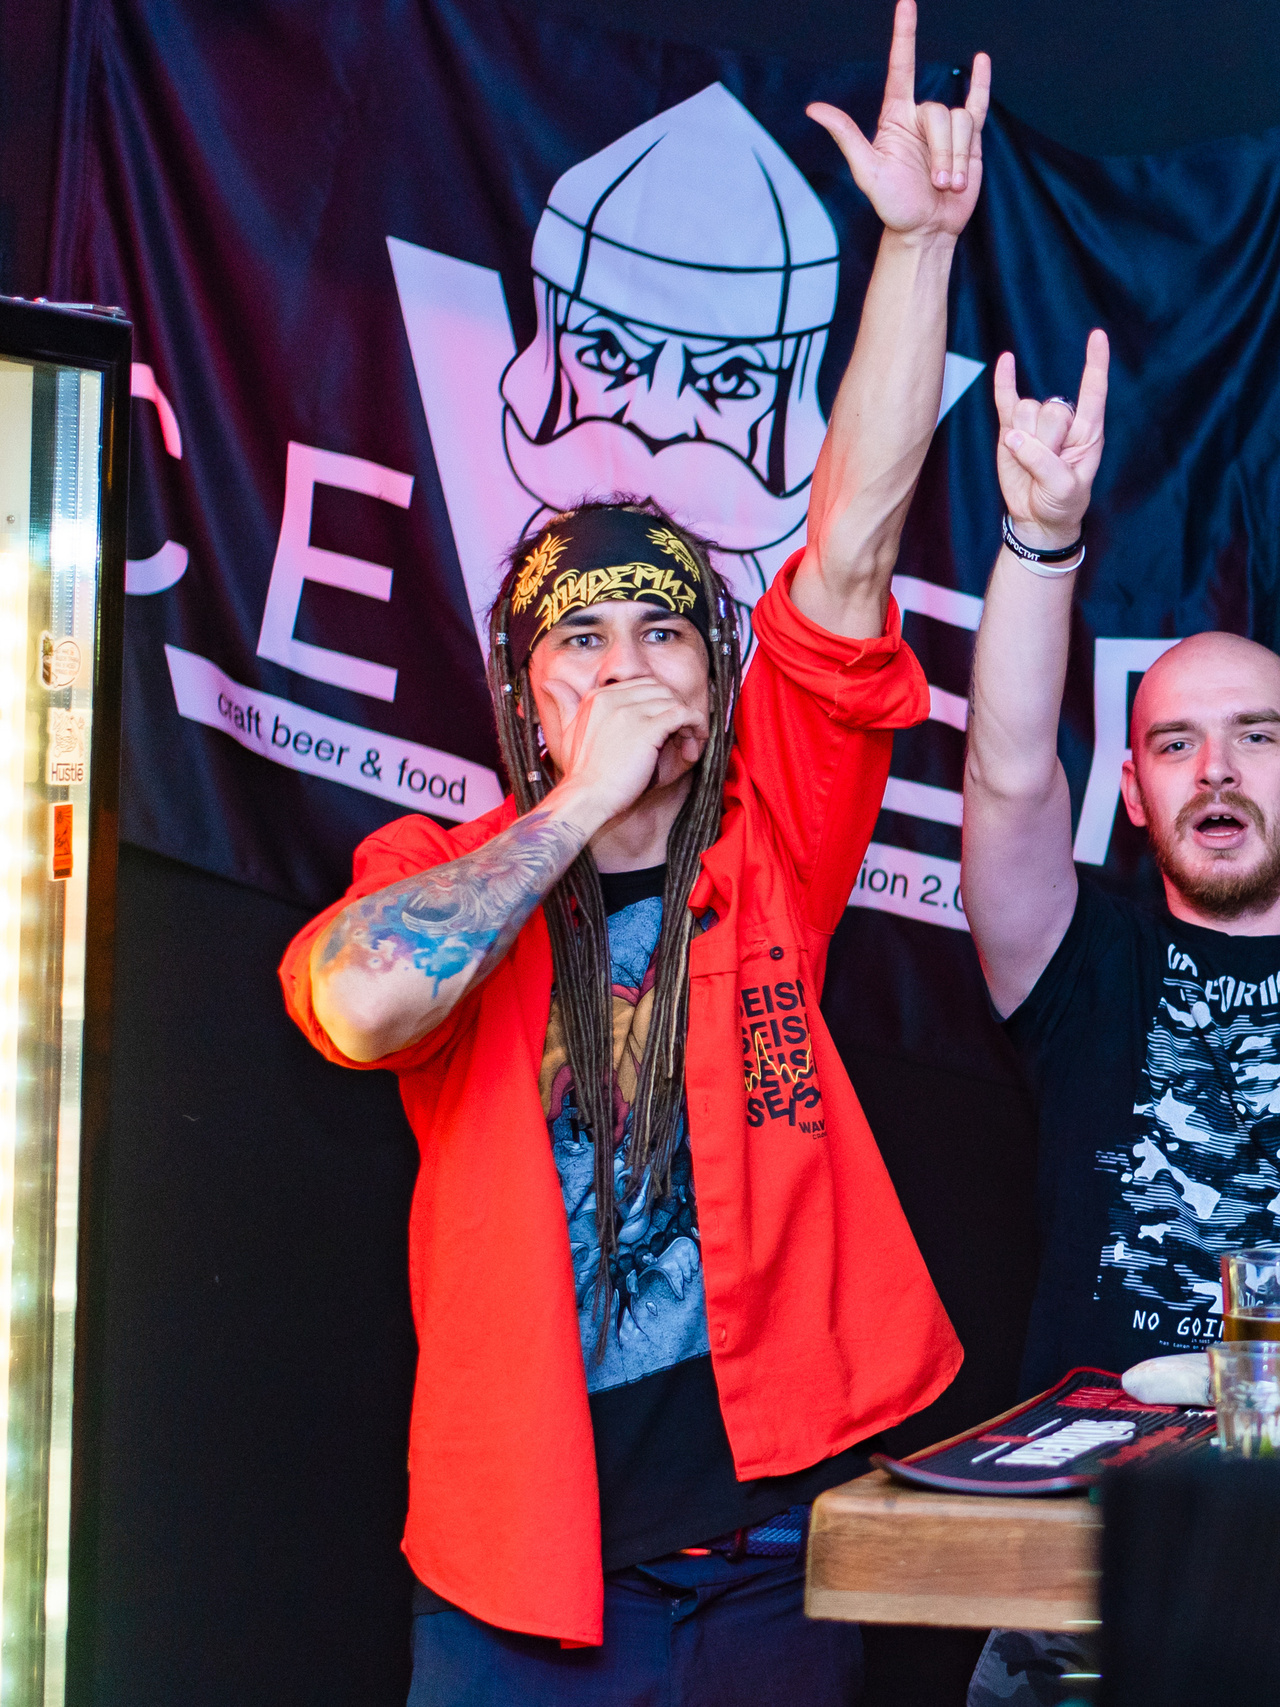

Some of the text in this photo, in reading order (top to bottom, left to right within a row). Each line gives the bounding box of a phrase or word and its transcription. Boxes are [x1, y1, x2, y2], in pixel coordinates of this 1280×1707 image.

[1006, 533, 1041, 562] ПРОСТИТ
[217, 692, 467, 806] craft beer & food
[855, 858, 909, 899] ion
[742, 1014, 811, 1054] SEIS
[744, 1049, 818, 1092] SEIS
[798, 1119, 825, 1133] WAV
[1132, 1309, 1160, 1331] NO
